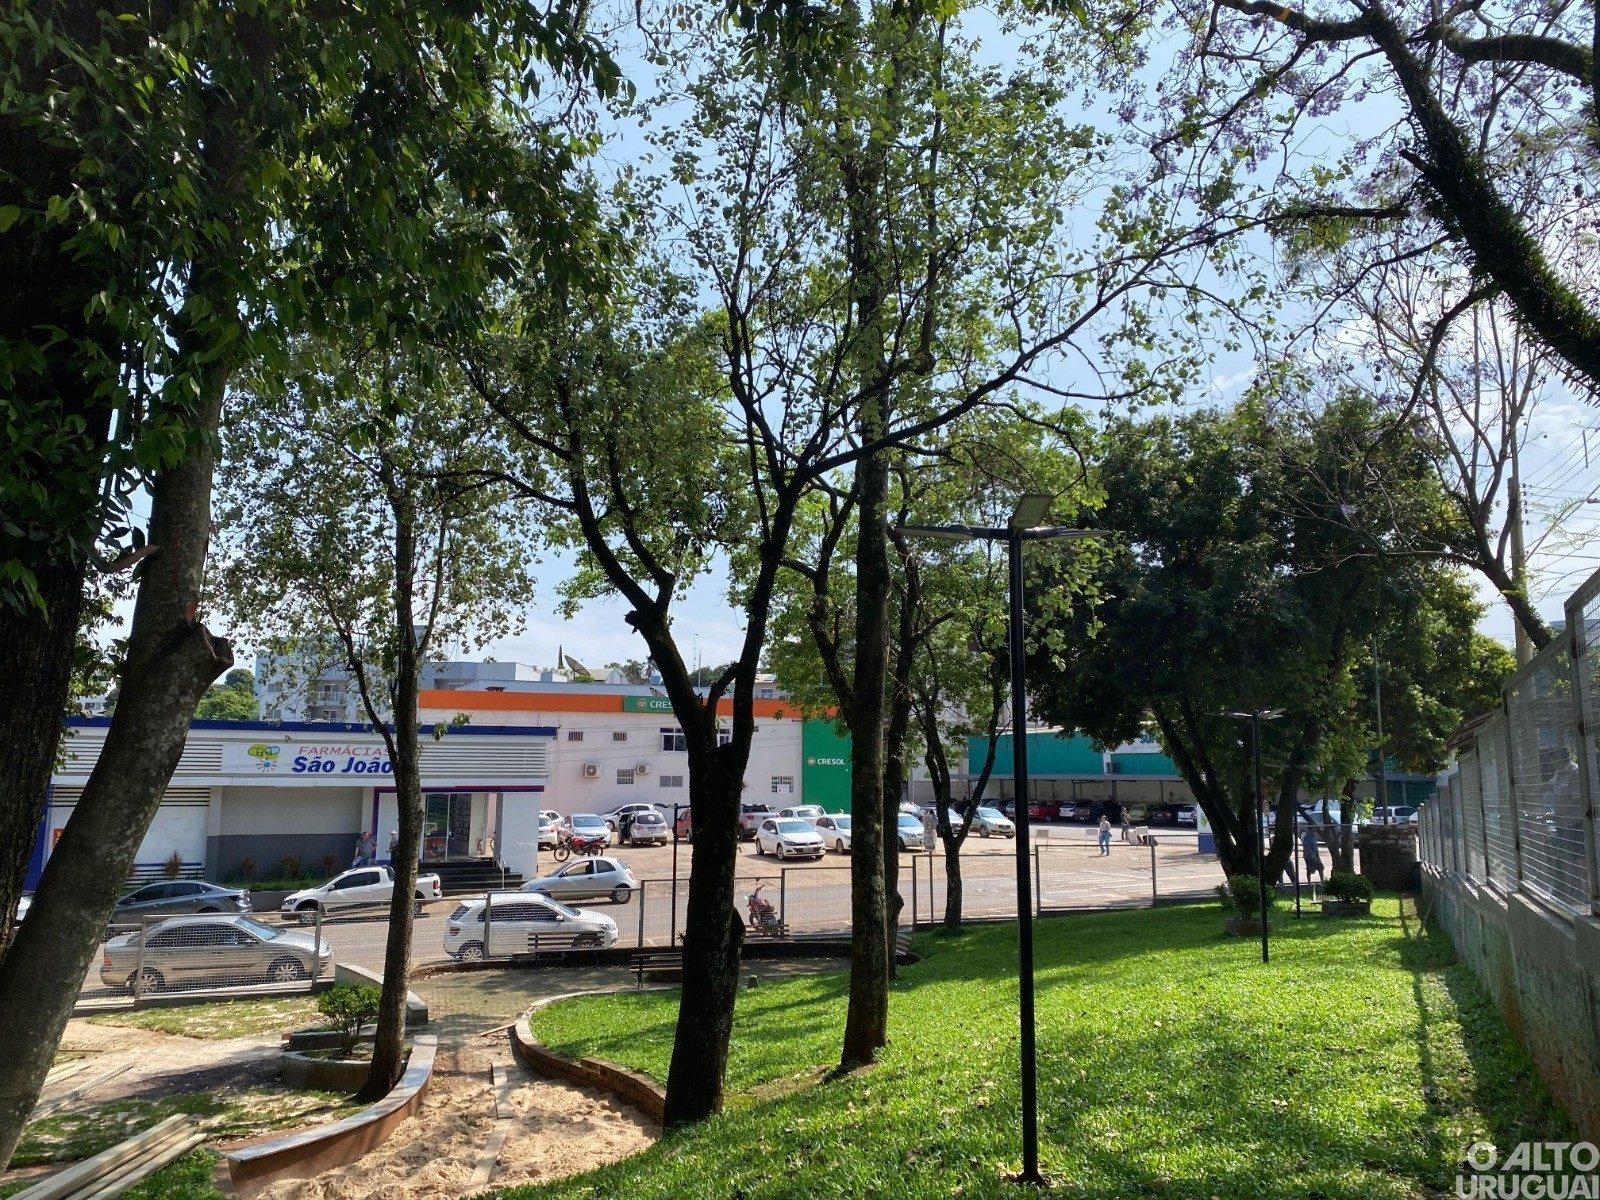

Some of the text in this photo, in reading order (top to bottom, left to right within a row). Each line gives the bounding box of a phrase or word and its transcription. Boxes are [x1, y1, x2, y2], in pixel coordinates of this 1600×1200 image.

[649, 700, 674, 709] CRES
[299, 745, 389, 756] FARMÁCIAS
[292, 756, 393, 774] São João
[817, 758, 845, 766] CRESOL
